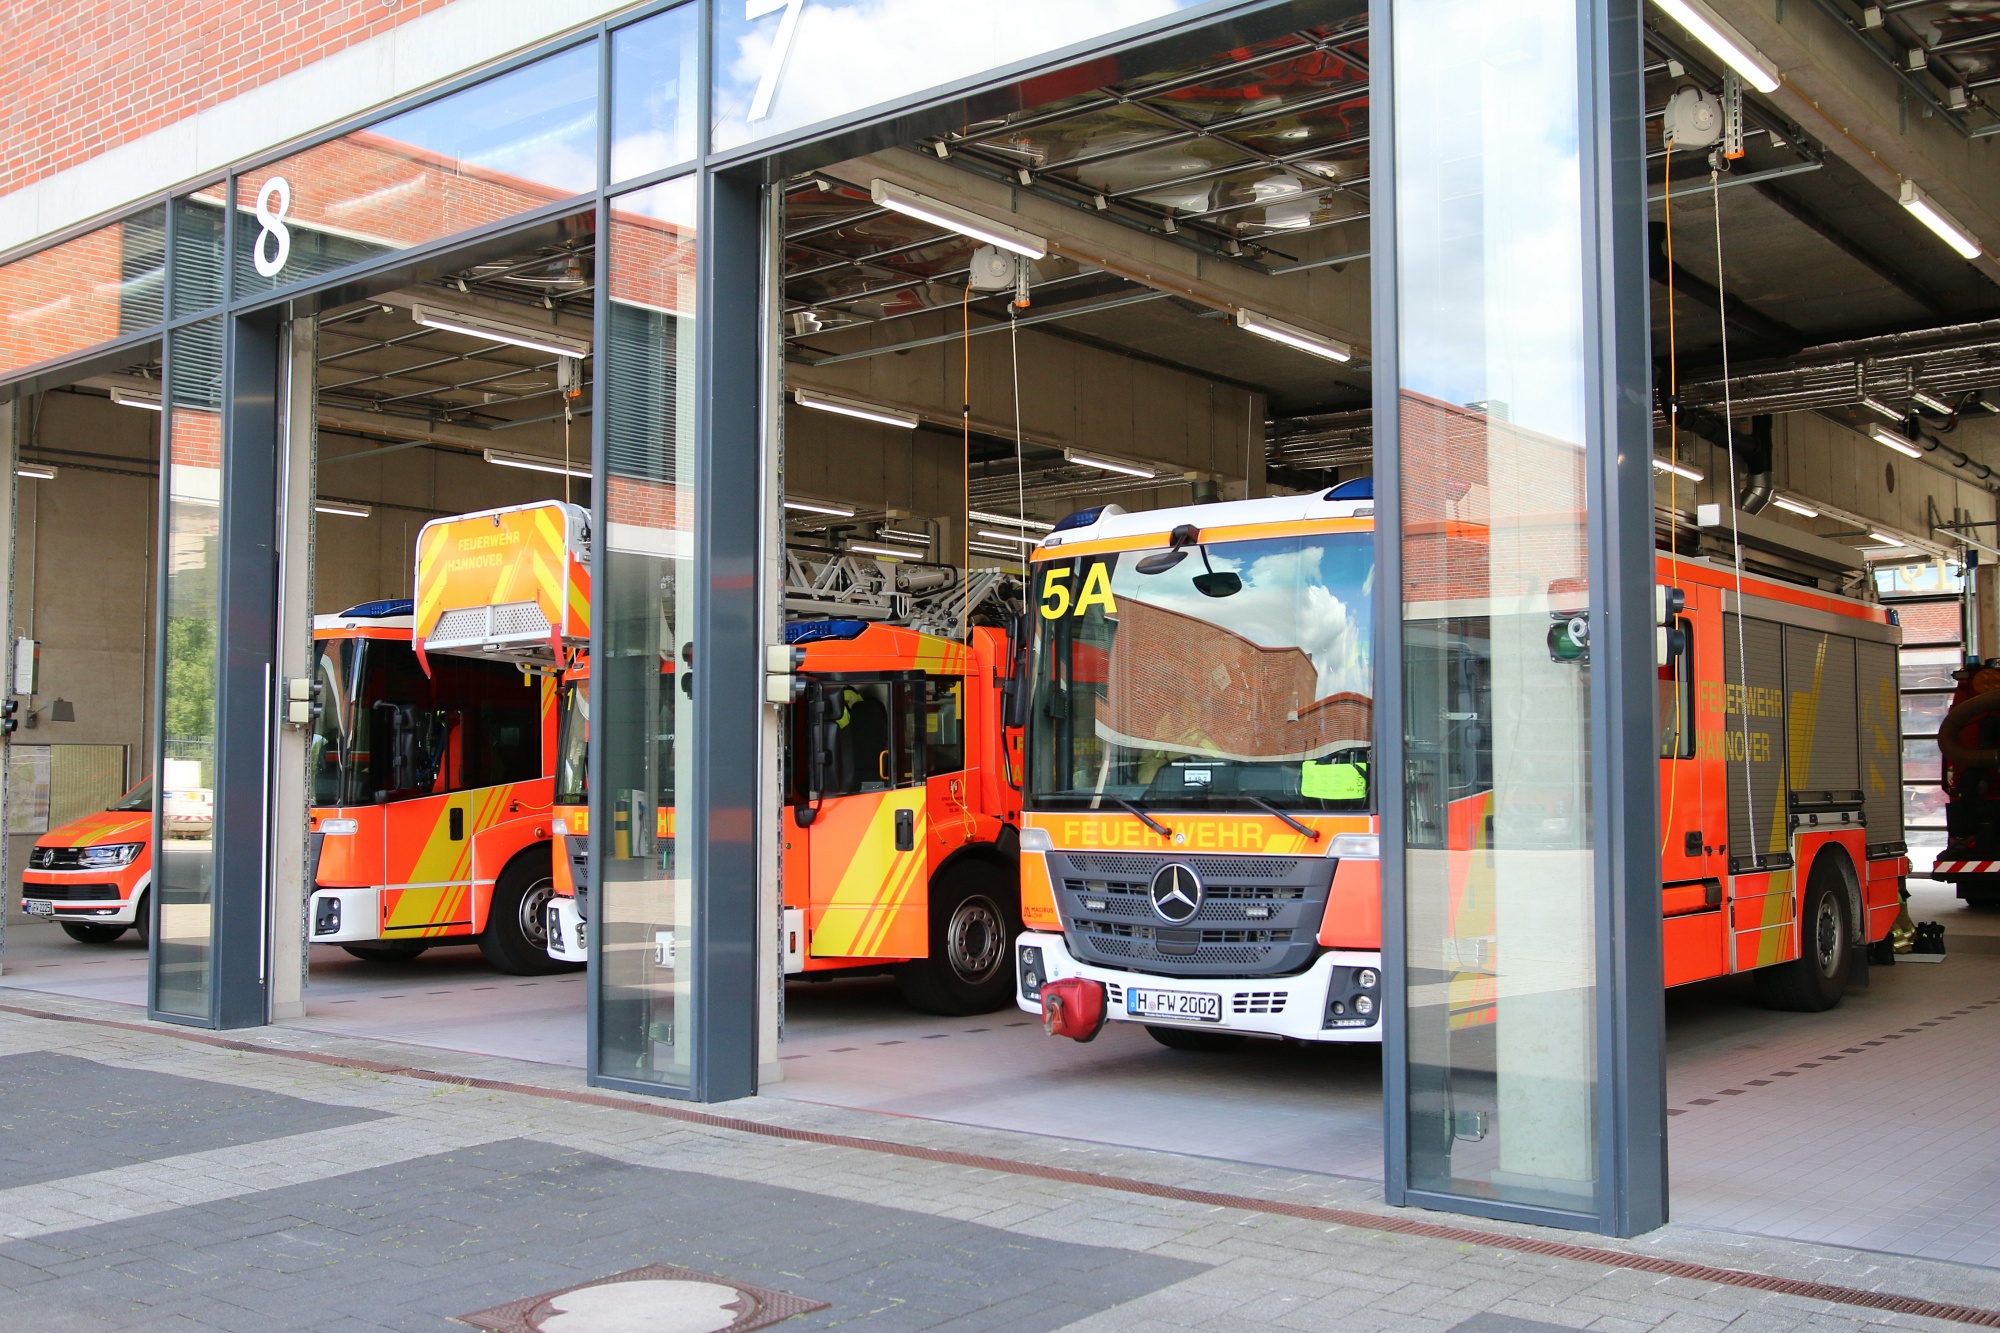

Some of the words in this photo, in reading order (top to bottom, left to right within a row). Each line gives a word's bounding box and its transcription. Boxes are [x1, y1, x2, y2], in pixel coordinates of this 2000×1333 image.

[745, 0, 804, 122] 7
[253, 176, 291, 277] 8
[458, 530, 520, 551] FEUERWEHR
[447, 552, 503, 572] HANNOVER
[1040, 562, 1118, 620] 5A
[566, 687, 575, 712] 1
[950, 681, 962, 720] 1
[1700, 680, 1783, 718] FEUERWEHR
[1695, 729, 1771, 762] HANNOVER
[1063, 820, 1264, 849] FEUERWEHR
[1138, 993, 1147, 1010] H
[1157, 994, 1176, 1012] FW
[1180, 996, 1216, 1015] 2002
